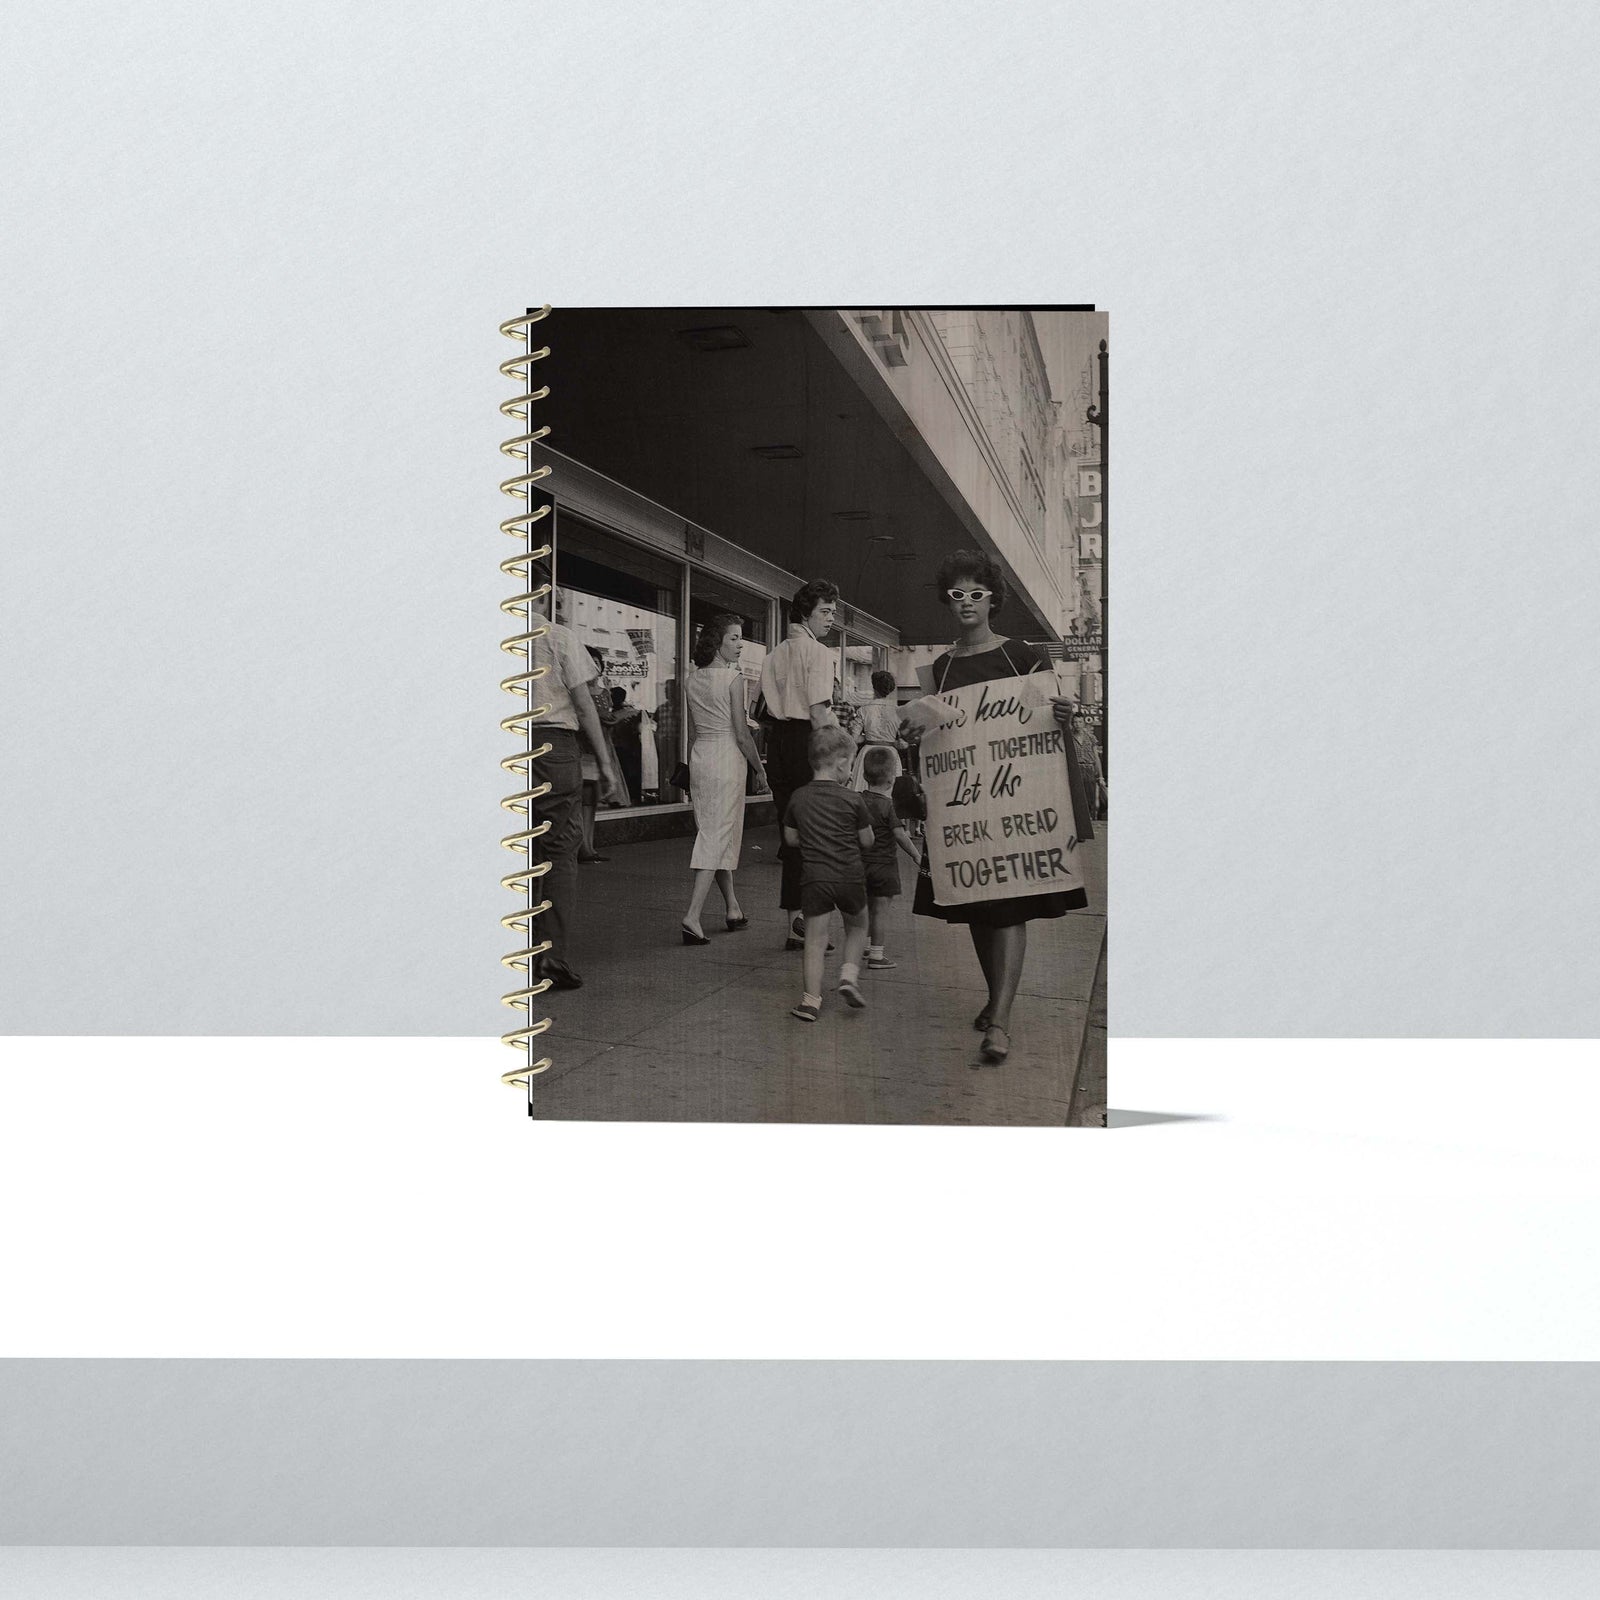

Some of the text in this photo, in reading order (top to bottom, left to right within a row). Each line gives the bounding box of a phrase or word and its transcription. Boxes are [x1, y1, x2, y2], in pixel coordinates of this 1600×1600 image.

[1065, 636, 1102, 646] DOLLAR
[925, 729, 1064, 778] FOUGHT TOGETHER
[946, 762, 1022, 807] Let Us
[942, 807, 1058, 848] BREAK BREAD
